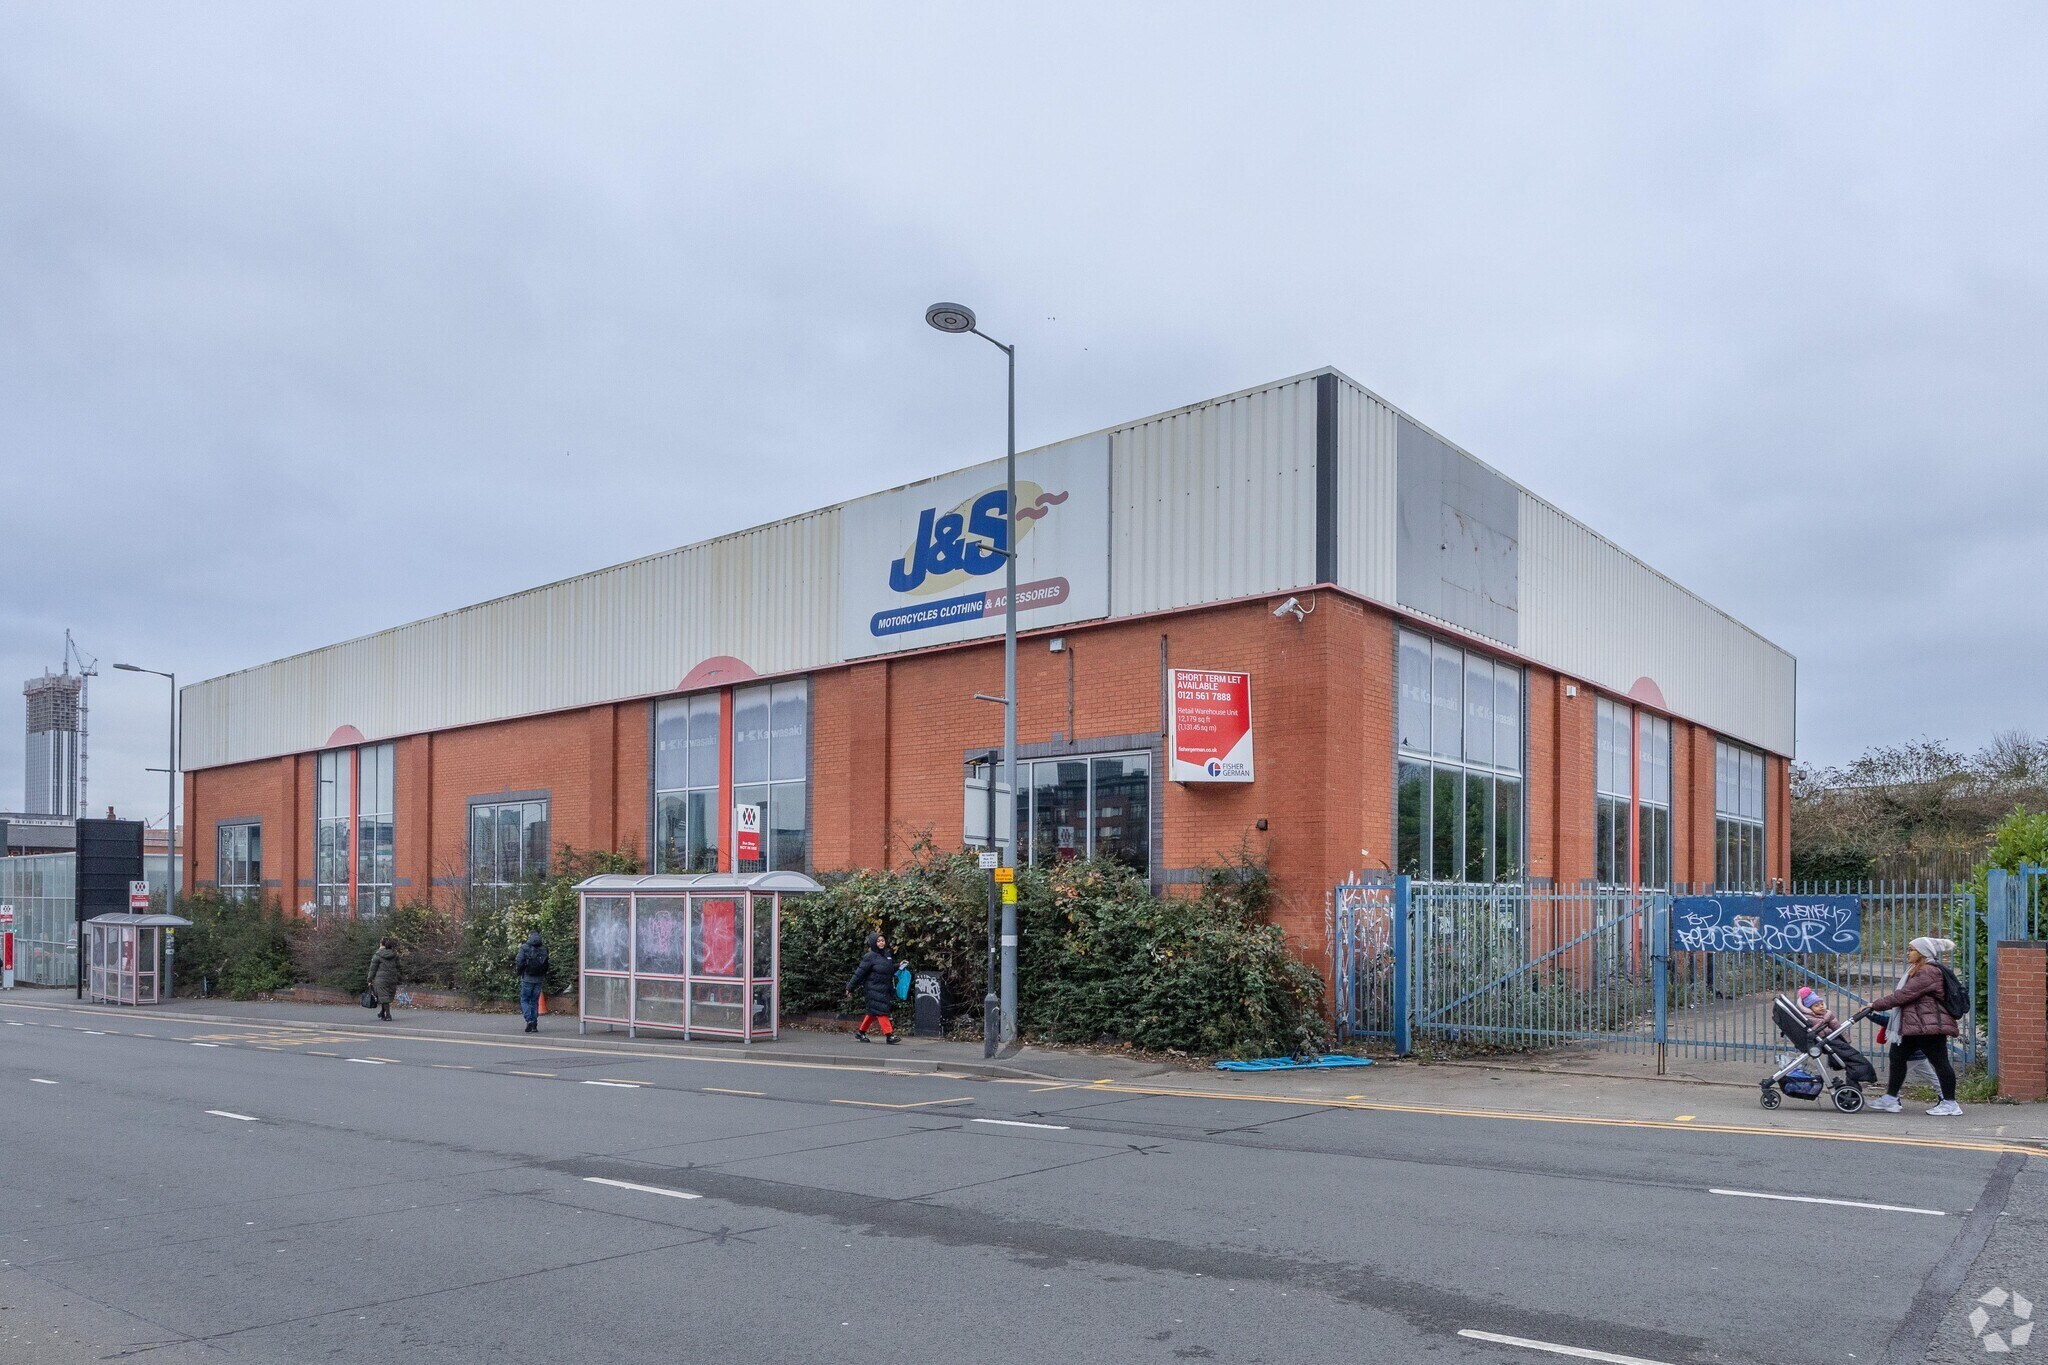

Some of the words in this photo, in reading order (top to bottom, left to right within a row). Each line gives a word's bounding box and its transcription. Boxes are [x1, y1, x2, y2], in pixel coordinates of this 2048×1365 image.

[889, 490, 1017, 592] J&S
[877, 608, 938, 629] MOTORCYCLES
[940, 601, 983, 618] CLOTHING
[985, 598, 993, 609] &
[994, 585, 1061, 608] ACESSORIES
[1177, 673, 1203, 682] SHORT
[1204, 675, 1227, 683] TERM
[1227, 676, 1242, 684] LET
[1177, 681, 1219, 690] AVAILABLE
[1177, 691, 1194, 700] 0121
[1195, 692, 1210, 700] 561
[1212, 693, 1232, 701] 7888
[757, 724, 803, 741] Kawasaki
[1208, 724, 1217, 733] m)
[677, 735, 717, 749] Kawasaki
[1222, 769, 1250, 777] GERMAN
